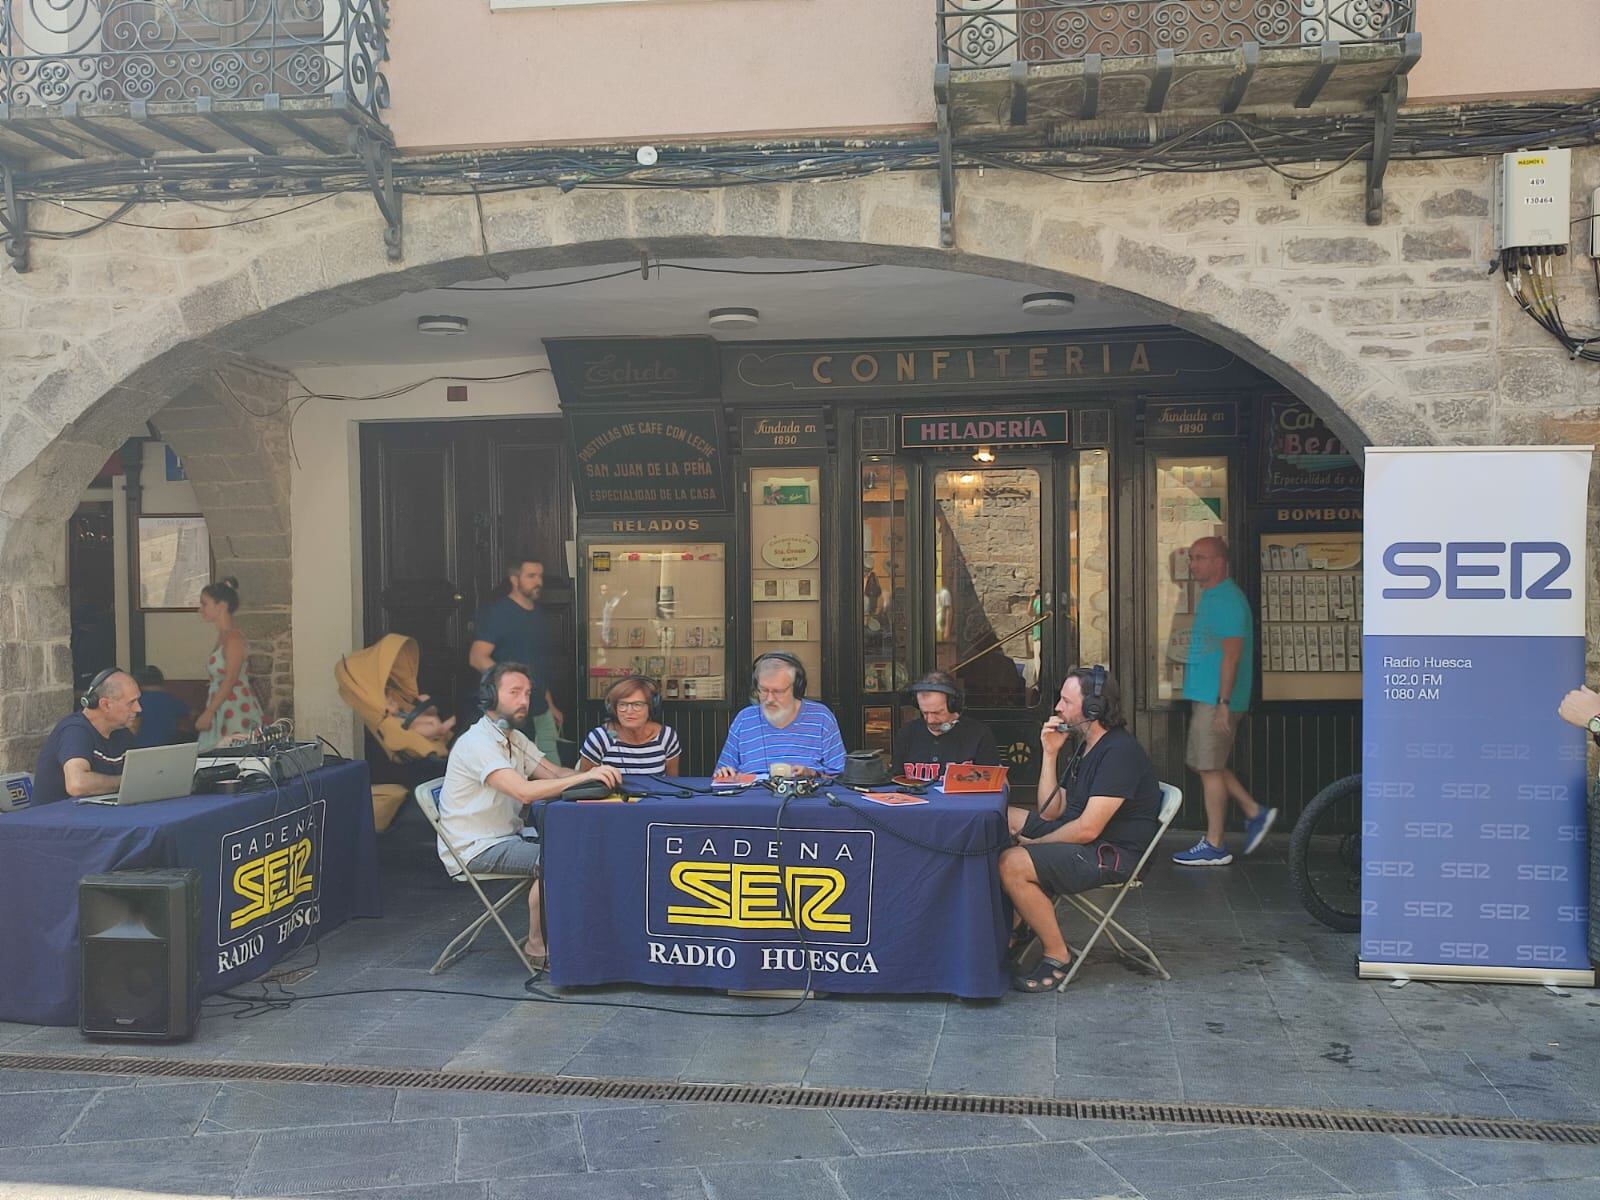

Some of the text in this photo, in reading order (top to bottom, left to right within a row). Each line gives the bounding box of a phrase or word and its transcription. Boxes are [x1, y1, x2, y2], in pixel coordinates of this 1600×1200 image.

[812, 343, 1151, 384] CONFITERIA
[1158, 407, 1224, 423] Fundada en
[752, 419, 816, 436] Fundada en
[920, 417, 1047, 441] HELADERÍA
[1179, 423, 1204, 434] 1890
[578, 421, 717, 462] PASTILLAS DE CAFE CON LECHE
[774, 434, 798, 446] 1890
[586, 458, 713, 477] SAN JUAN DE LA PEÑA
[1334, 472, 1345, 485] de
[589, 487, 717, 501] ESPECIALIDAD DE LA CASA
[612, 519, 700, 532] HELADOS
[1382, 542, 1572, 600] SER
[1383, 656, 1472, 669] Radio Huesca
[1384, 674, 1442, 686] 102.0 FM
[1384, 688, 1439, 700] 1080 AM
[1559, 745, 1587, 760] SE
[1367, 782, 1568, 800] SER SER SER
[231, 815, 317, 861] CADENA
[1405, 822, 1587, 841] SER SER SE
[666, 837, 853, 861] CADENA
[1366, 861, 1568, 881] SER SER SER
[230, 837, 313, 930] SER
[667, 860, 851, 933] SER
[1404, 901, 1588, 921] SER SER SE
[217, 934, 264, 974] RADIO
[648, 941, 879, 974] RADIO HUESCA
[1364, 940, 1567, 962] SER SER SER
